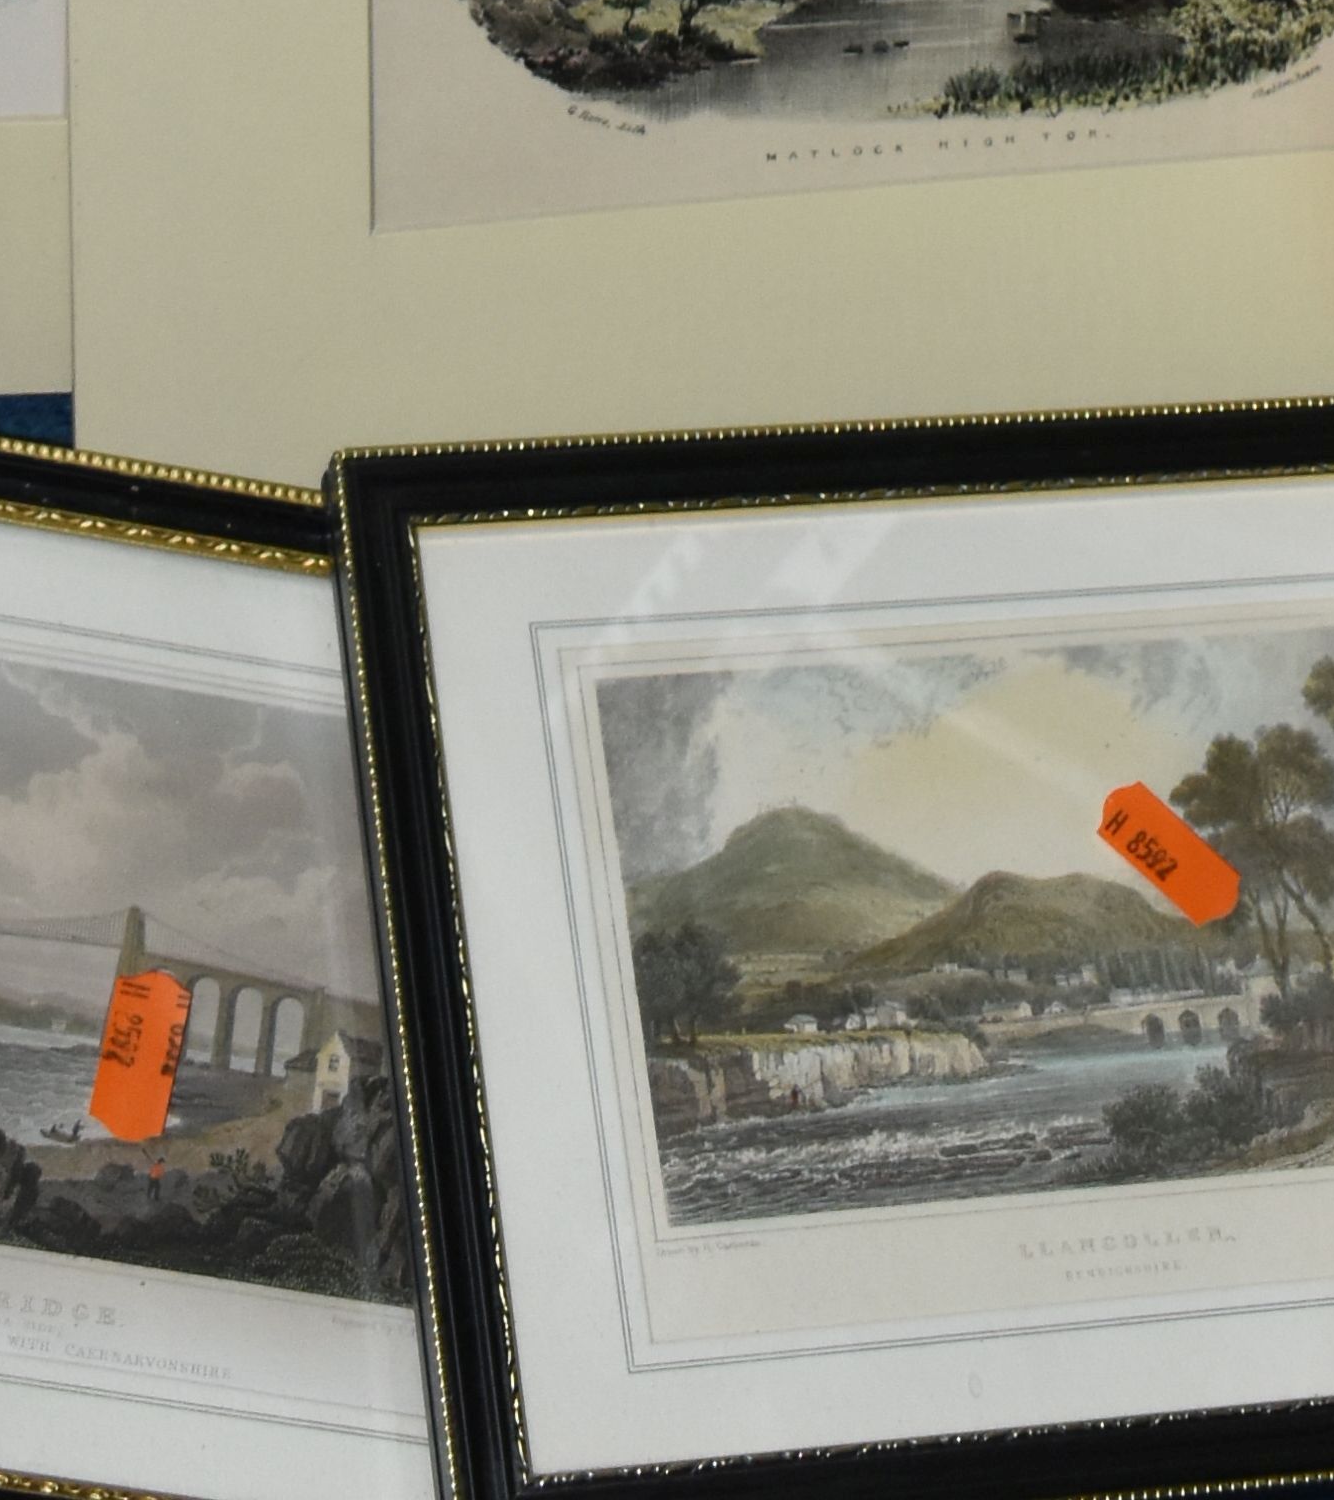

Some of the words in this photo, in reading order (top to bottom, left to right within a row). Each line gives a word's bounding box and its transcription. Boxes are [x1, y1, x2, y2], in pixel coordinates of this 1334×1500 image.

[766, 143, 905, 164] MATLOCK
[939, 134, 1017, 151] HIGH
[1105, 809, 1129, 836] H
[1126, 830, 1179, 883] 8592
[7, 1334, 51, 1354] WITH
